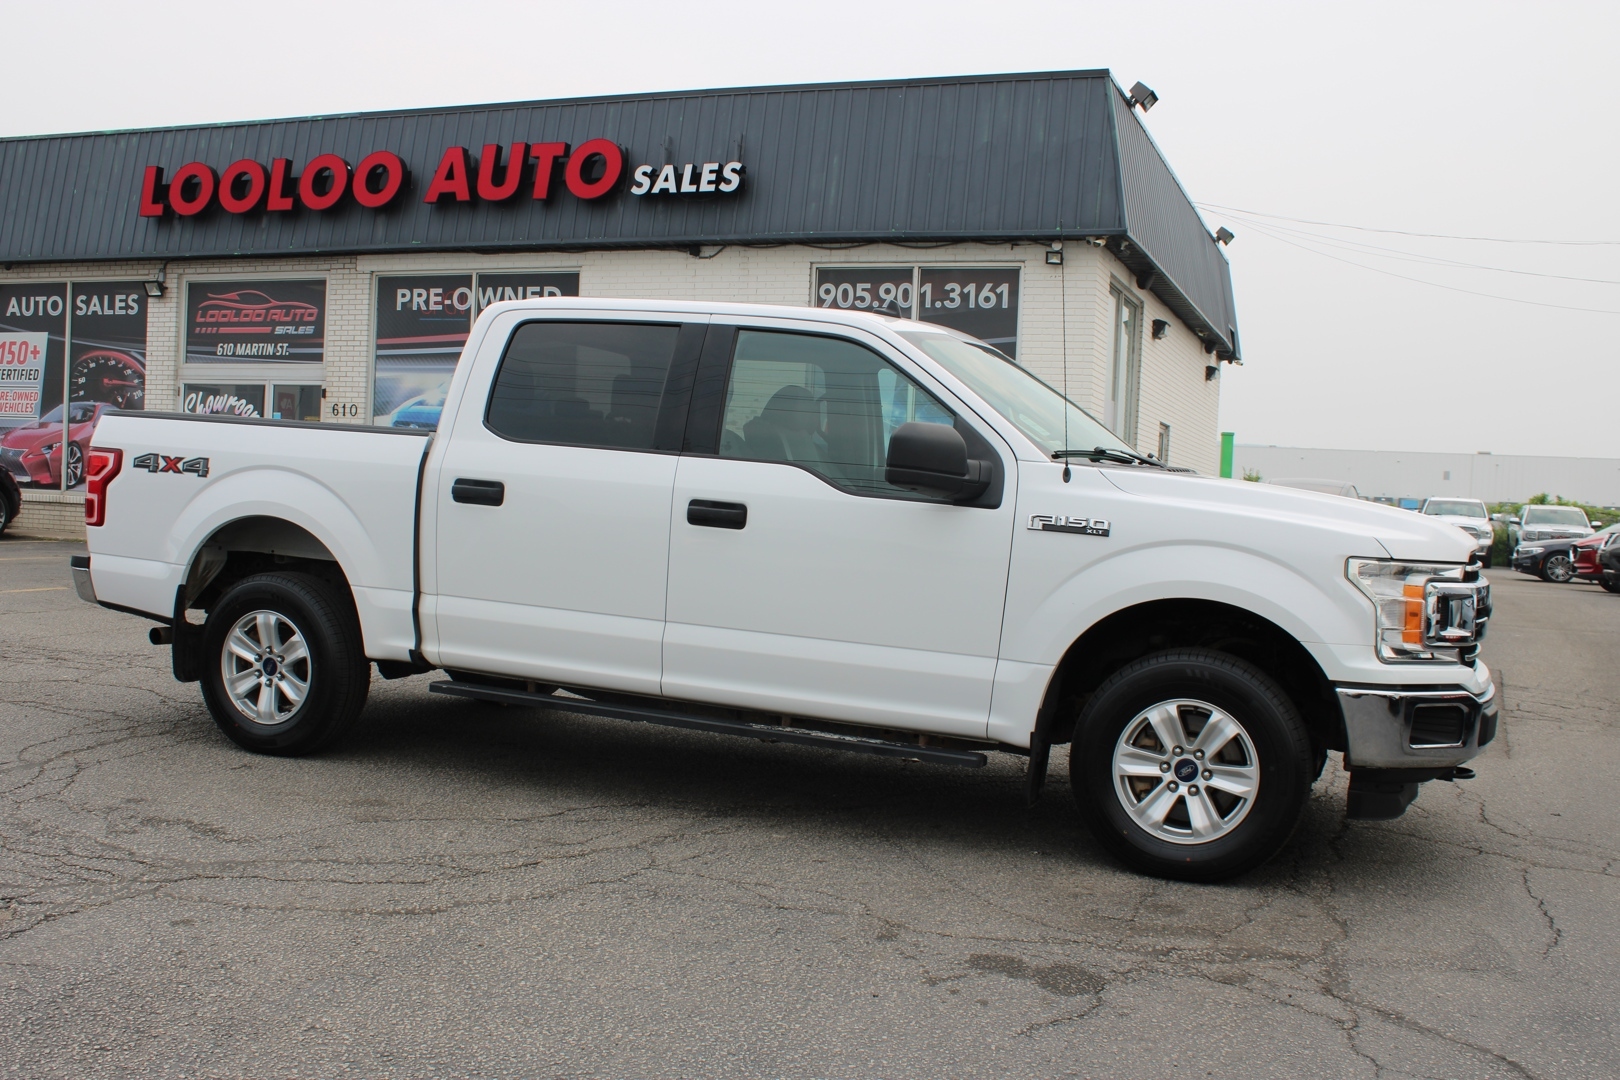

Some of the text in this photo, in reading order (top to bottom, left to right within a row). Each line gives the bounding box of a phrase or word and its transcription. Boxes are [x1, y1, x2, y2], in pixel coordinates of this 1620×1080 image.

[140, 138, 745, 217] LOOLOO AUTO SALES
[819, 282, 1010, 309] 905.901.3161
[5, 293, 139, 317] AUTO SALES
[195, 309, 319, 323] LOOLOO AUTO
[274, 325, 315, 335] SALES
[216, 343, 290, 356] 610 MARTIN ST.
[0, 368, 40, 381] ERTIFIED
[0, 391, 39, 402] RE-OWNED
[332, 403, 358, 417] 610
